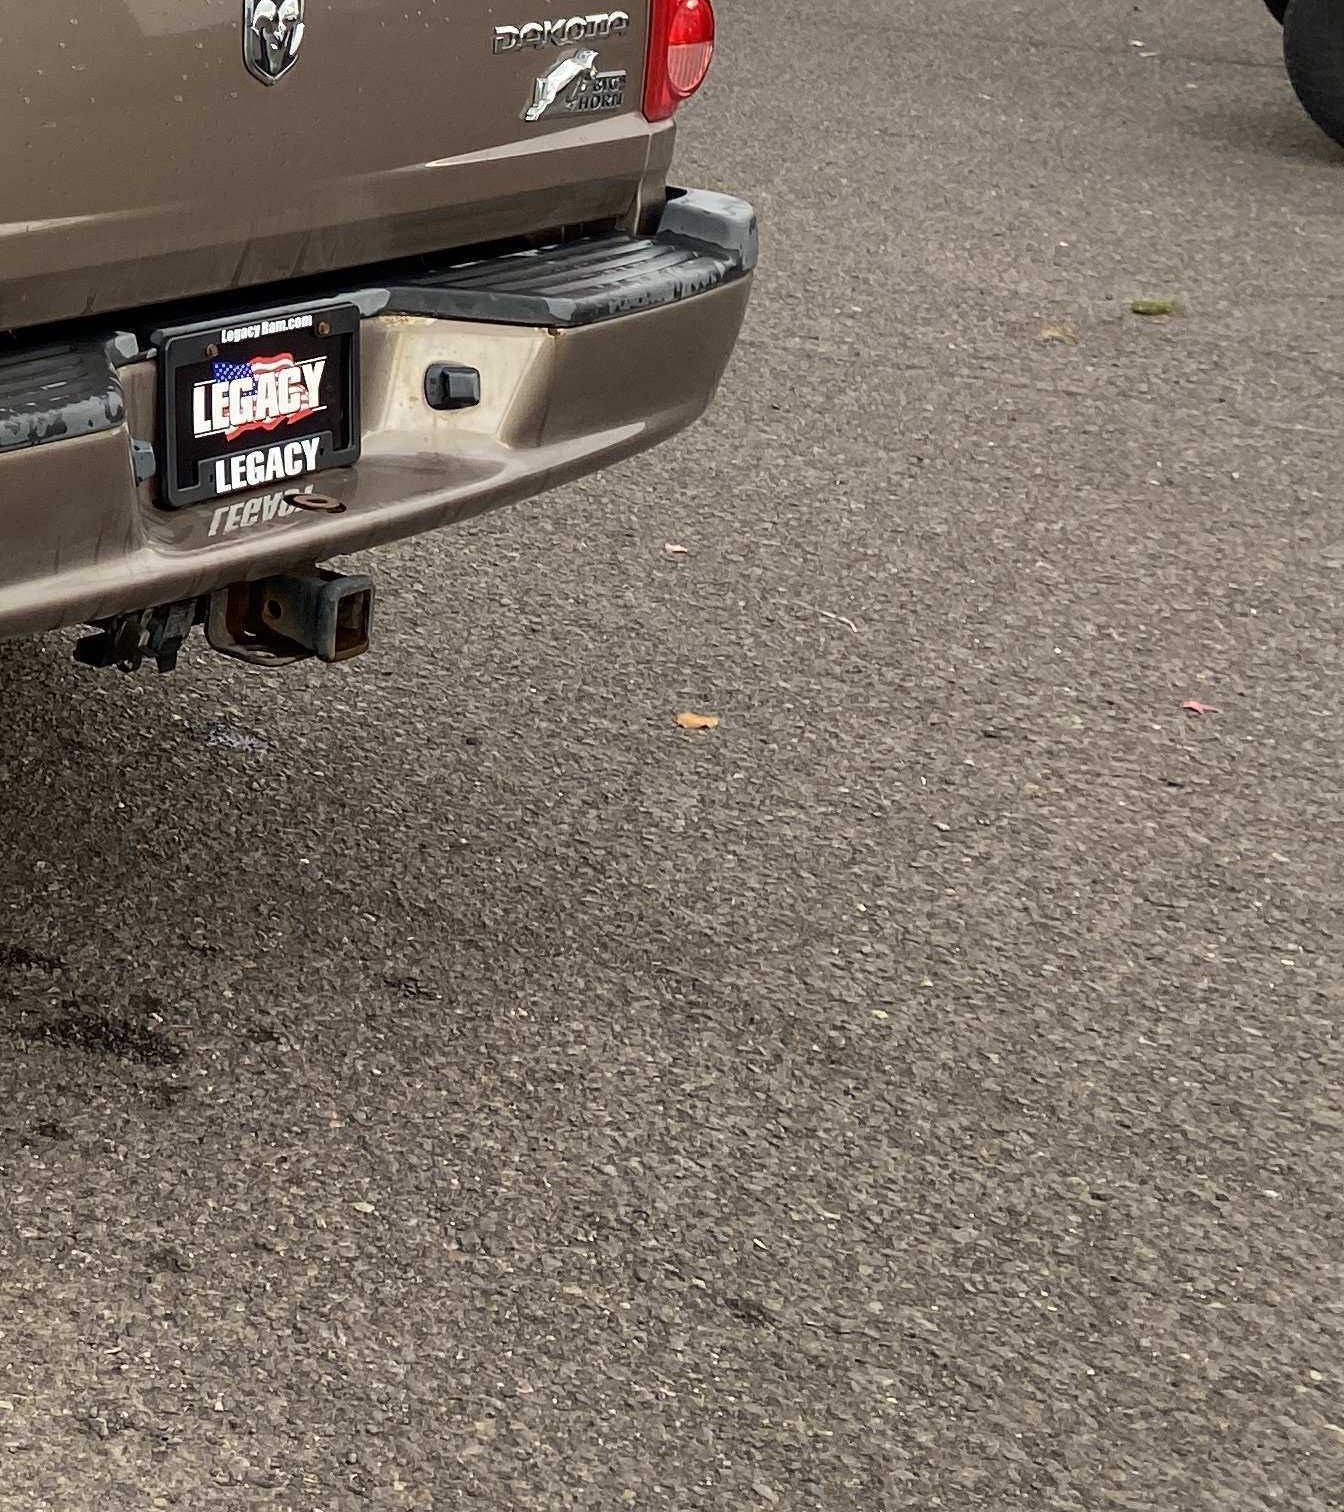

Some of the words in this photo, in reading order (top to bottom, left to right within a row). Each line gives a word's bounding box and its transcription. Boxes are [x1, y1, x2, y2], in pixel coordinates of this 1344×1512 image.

[492, 11, 629, 54] DAKOTA
[578, 92, 624, 110] HORN
[193, 360, 326, 435] LEGACY
[215, 437, 320, 494] LEGACY
